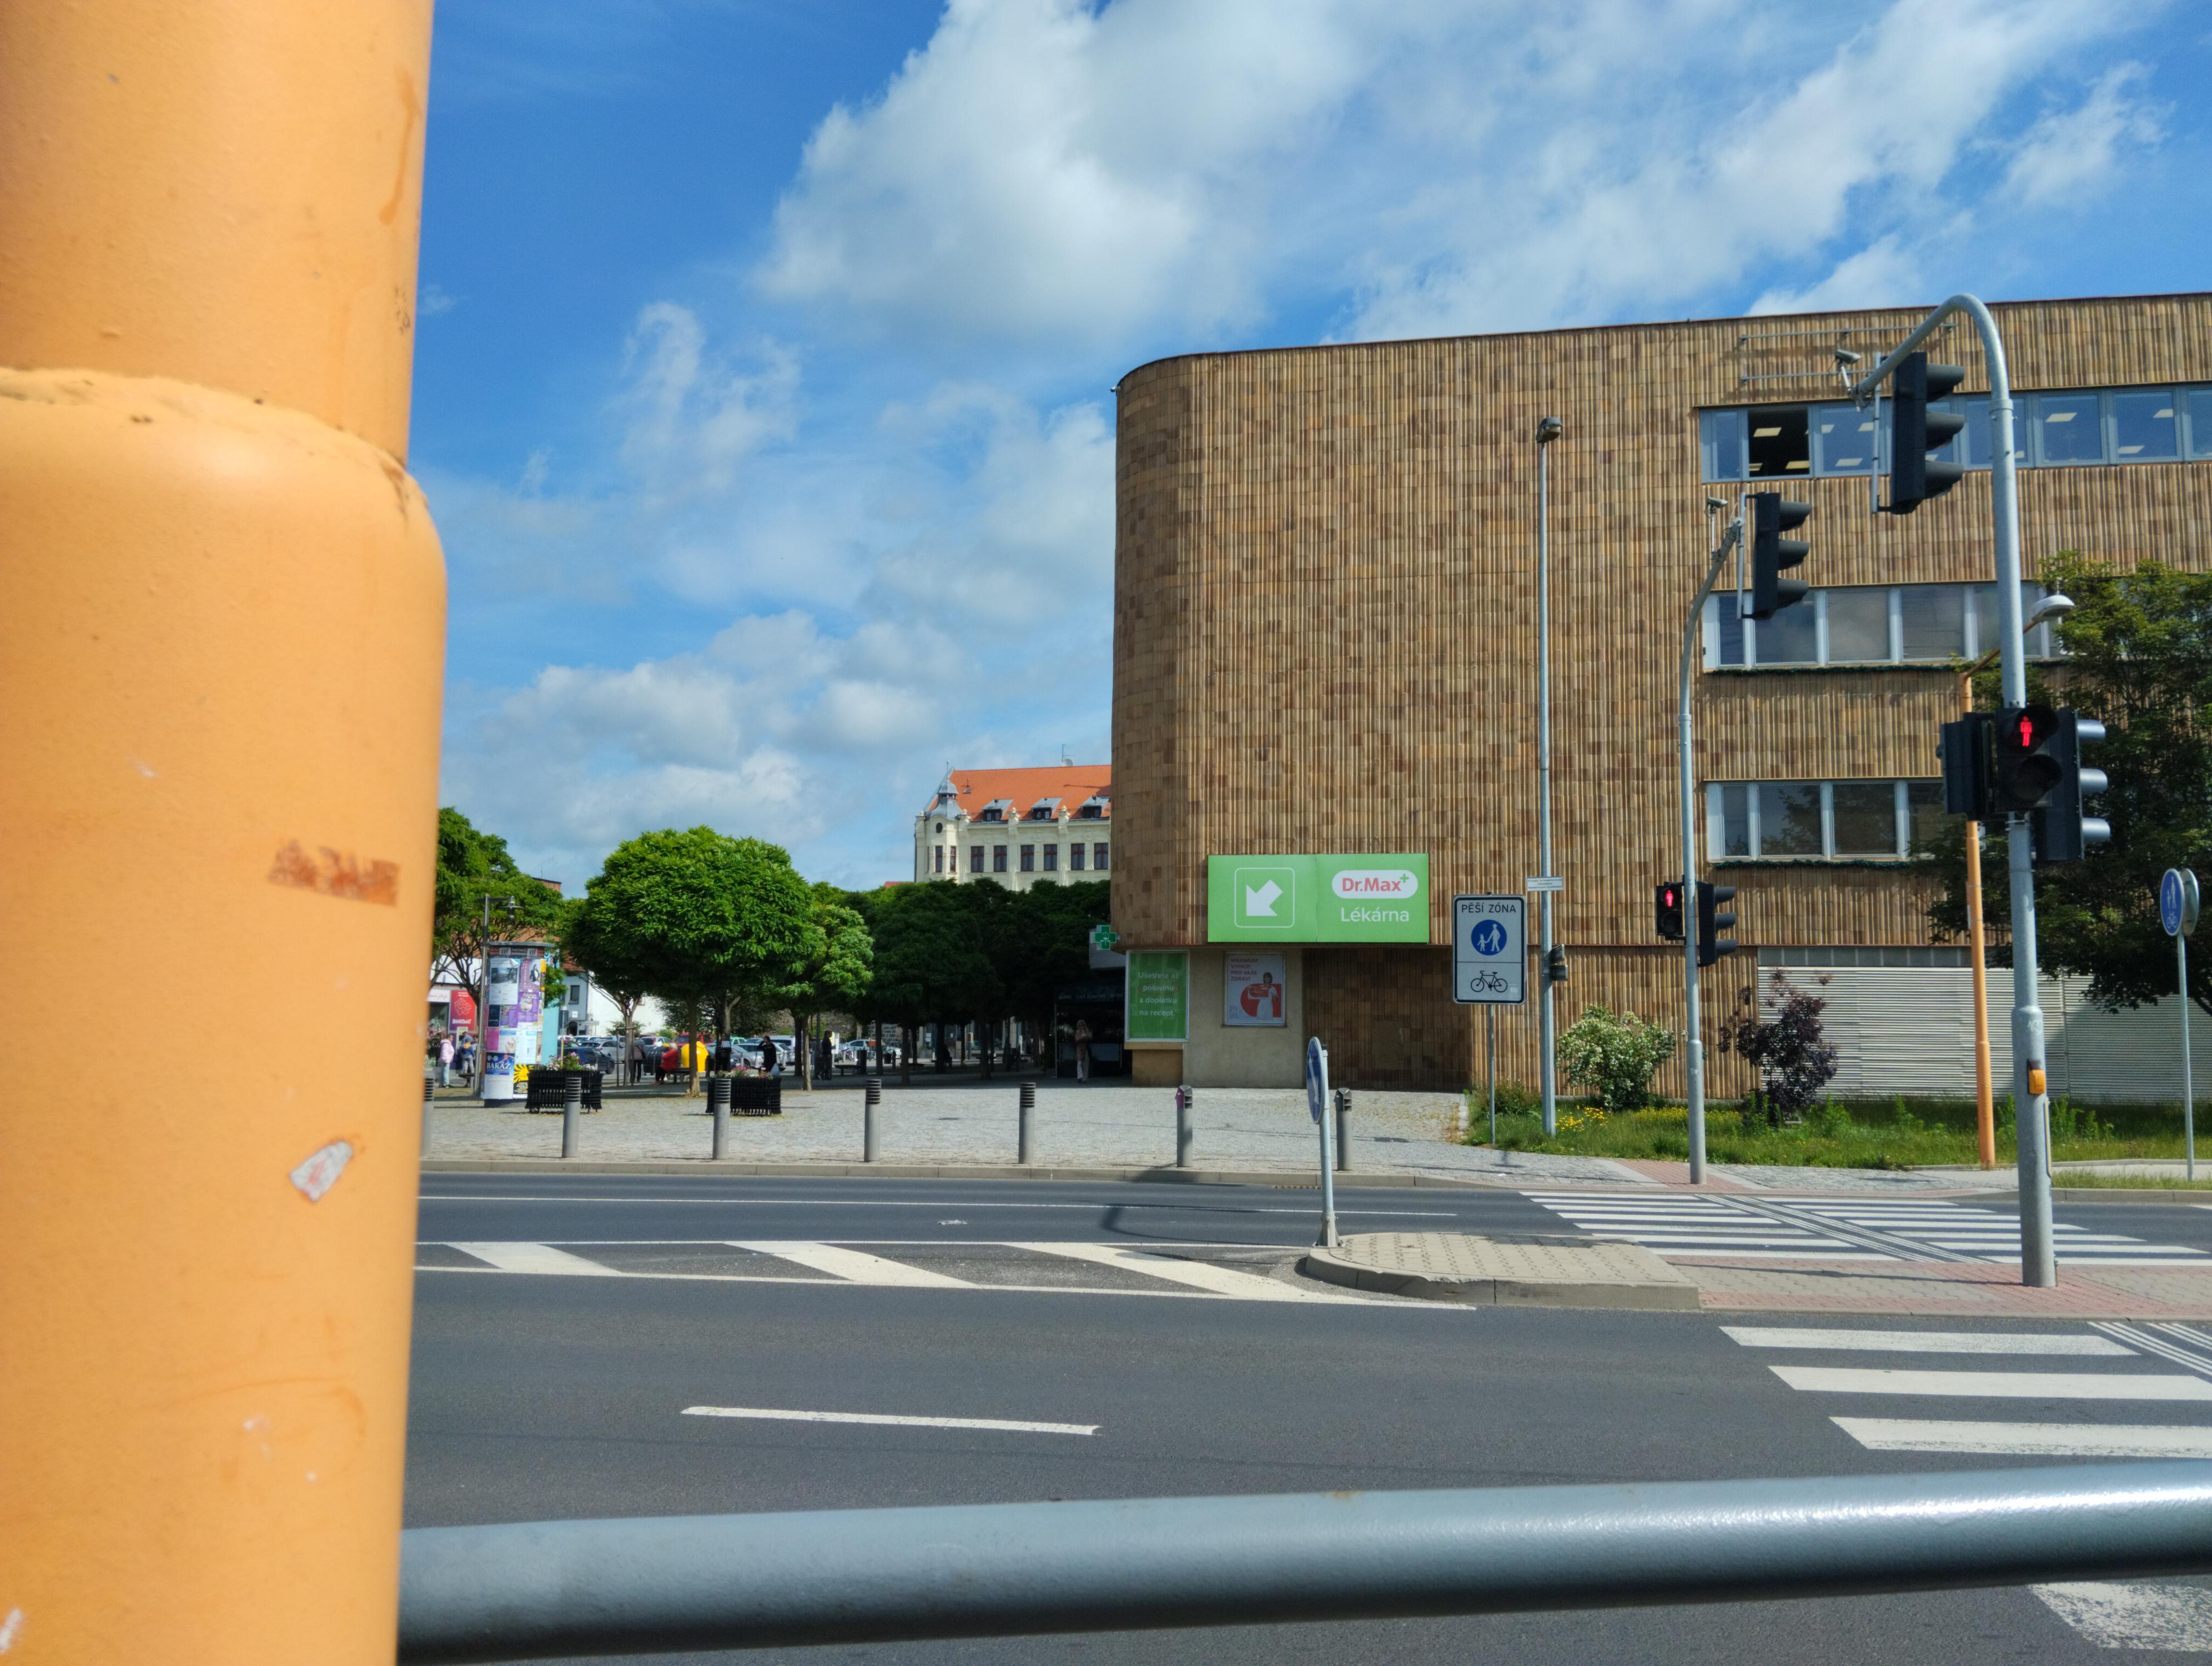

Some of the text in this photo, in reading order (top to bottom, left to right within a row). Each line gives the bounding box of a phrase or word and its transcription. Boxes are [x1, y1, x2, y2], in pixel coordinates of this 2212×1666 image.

[1461, 902, 1516, 913] PĚŠÍ ZÓNA
[1341, 907, 1409, 922] Lékárna
